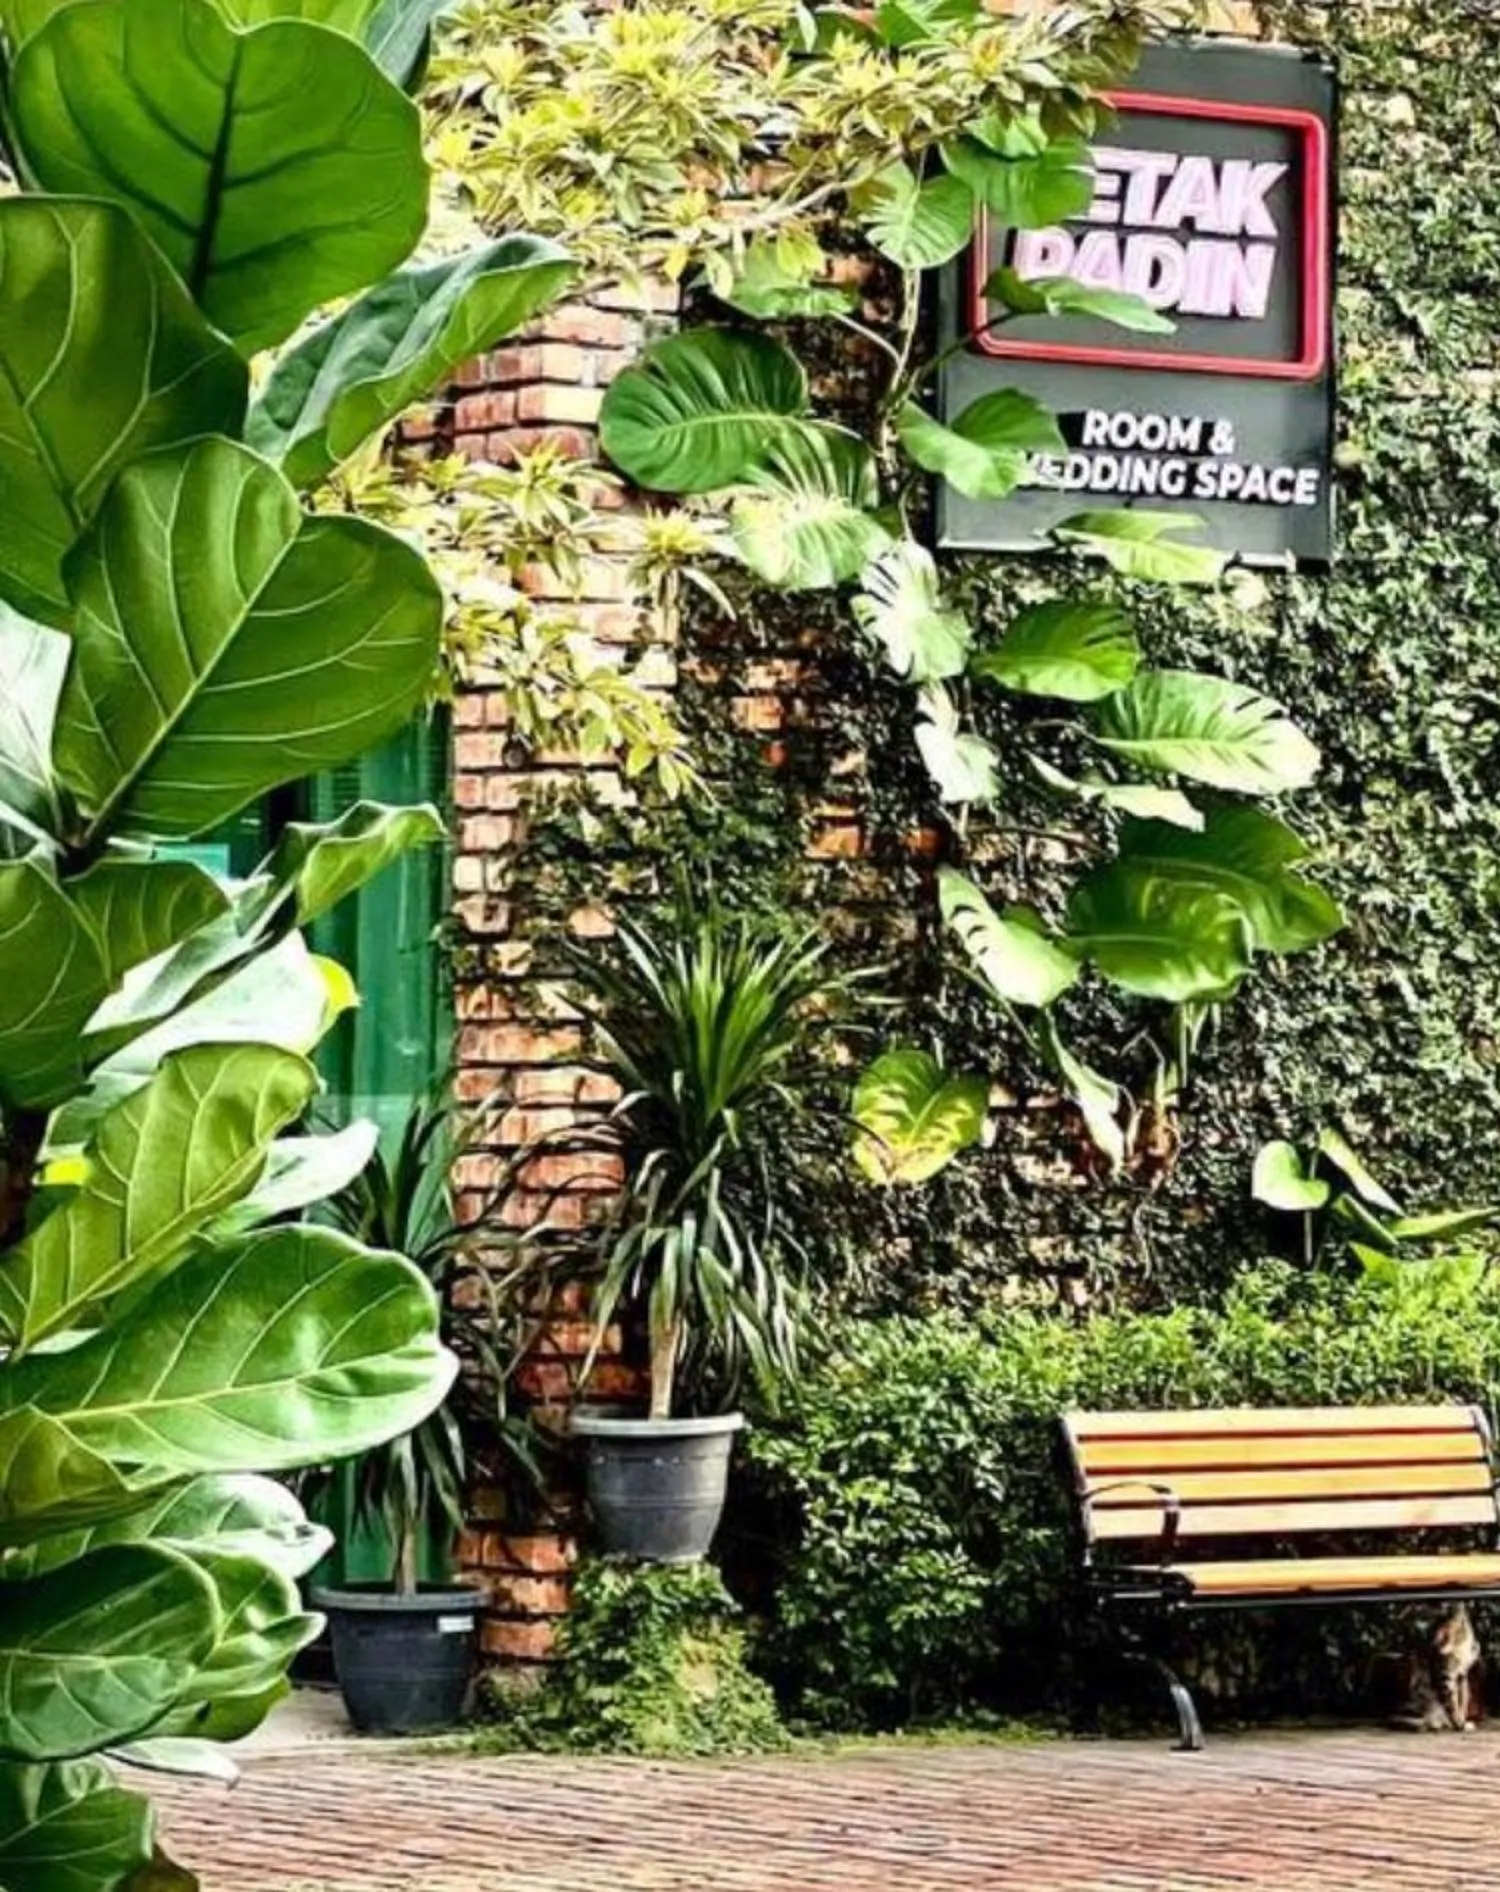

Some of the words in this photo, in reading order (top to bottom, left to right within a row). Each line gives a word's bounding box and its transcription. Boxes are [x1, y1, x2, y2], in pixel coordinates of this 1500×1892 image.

[1065, 146, 1289, 237] ETAK
[1082, 409, 1200, 452] ROOM
[1209, 419, 1236, 453] &
[1193, 462, 1320, 507] SPACE
